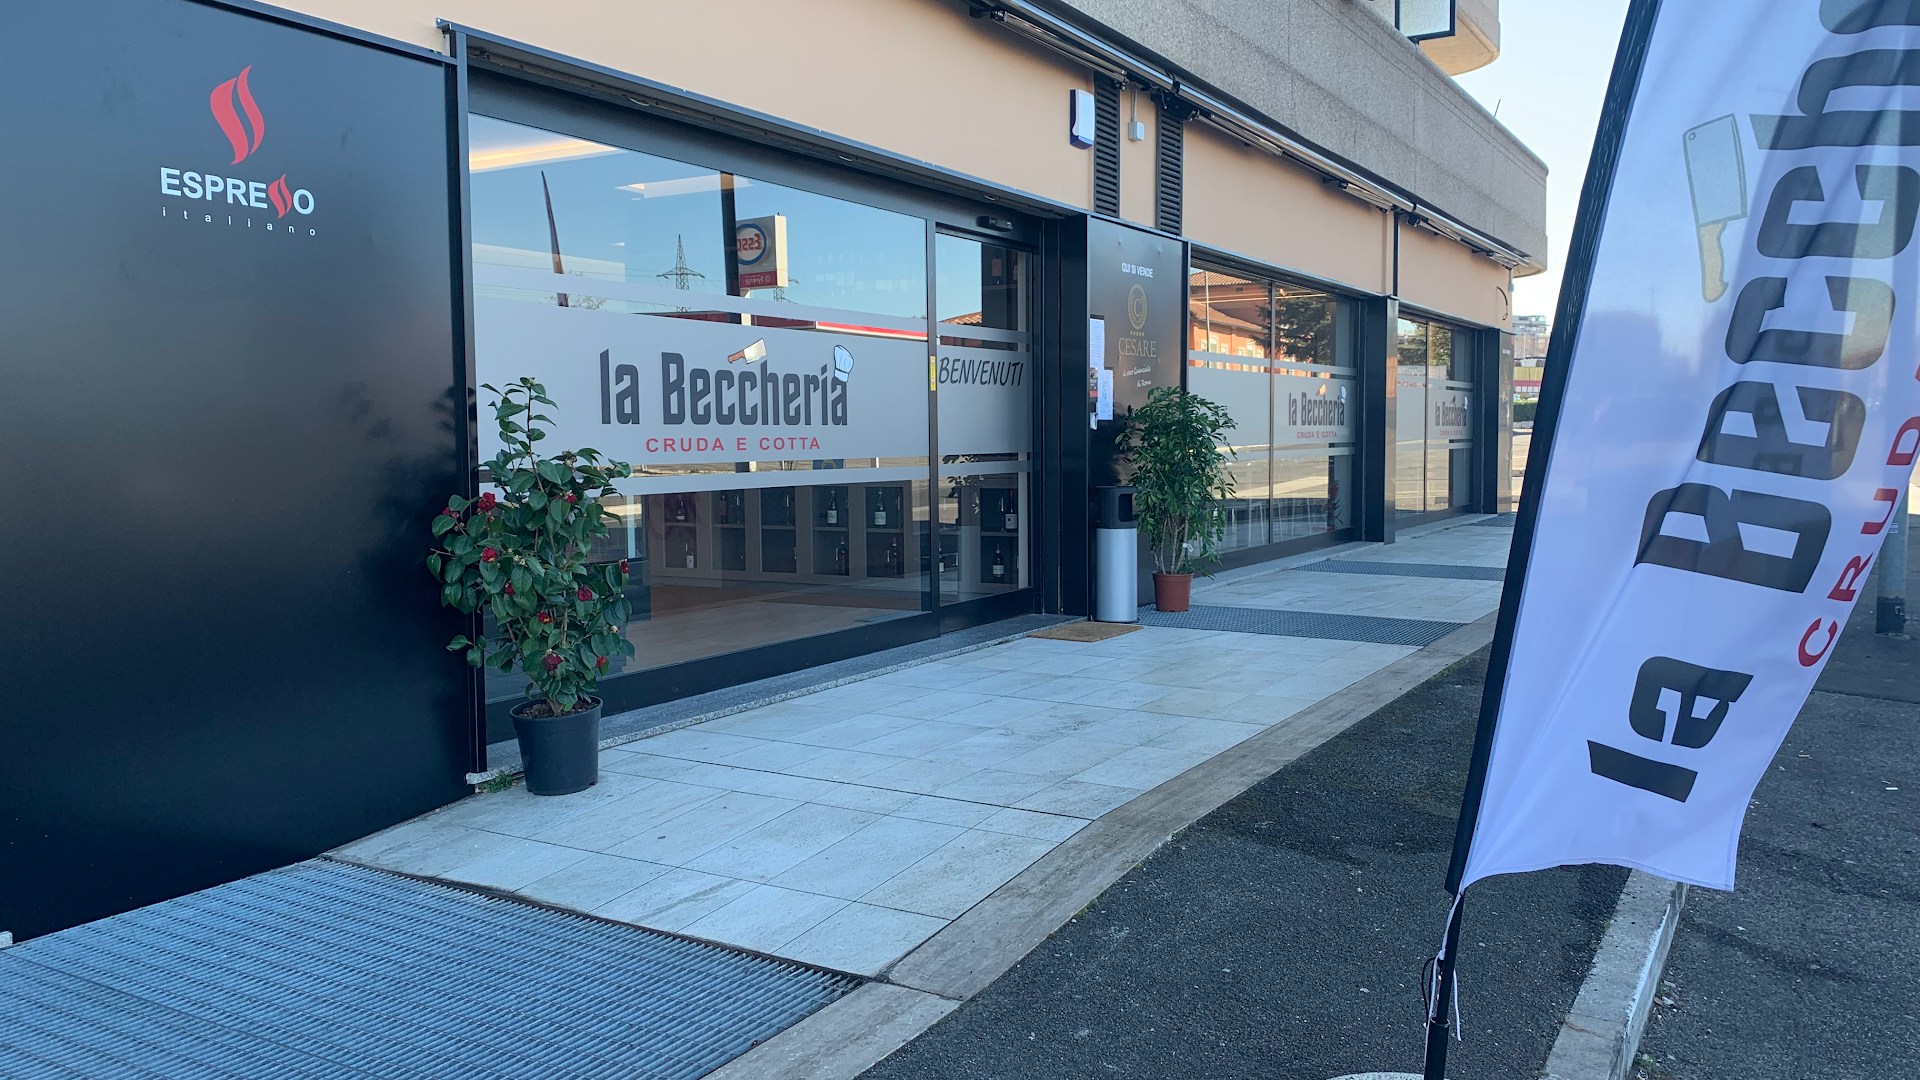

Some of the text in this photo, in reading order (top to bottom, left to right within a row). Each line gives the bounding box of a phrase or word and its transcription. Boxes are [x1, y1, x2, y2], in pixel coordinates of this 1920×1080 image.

[162, 206, 316, 236] italiano
[1122, 262, 1153, 278] QUI SI VENDE
[1633, 0, 1920, 594] Becch
[1118, 338, 1156, 358] CESARE
[938, 356, 1024, 387] BENVENUTI
[600, 349, 640, 425] la
[661, 351, 848, 426] Beccheria
[1288, 392, 1345, 426] la Beccheria
[645, 437, 821, 453] CRUDA E COTTA
[1297, 431, 1315, 439] CRUDA
[1798, 365, 1920, 667] CRUD
[1587, 656, 1754, 803] la
